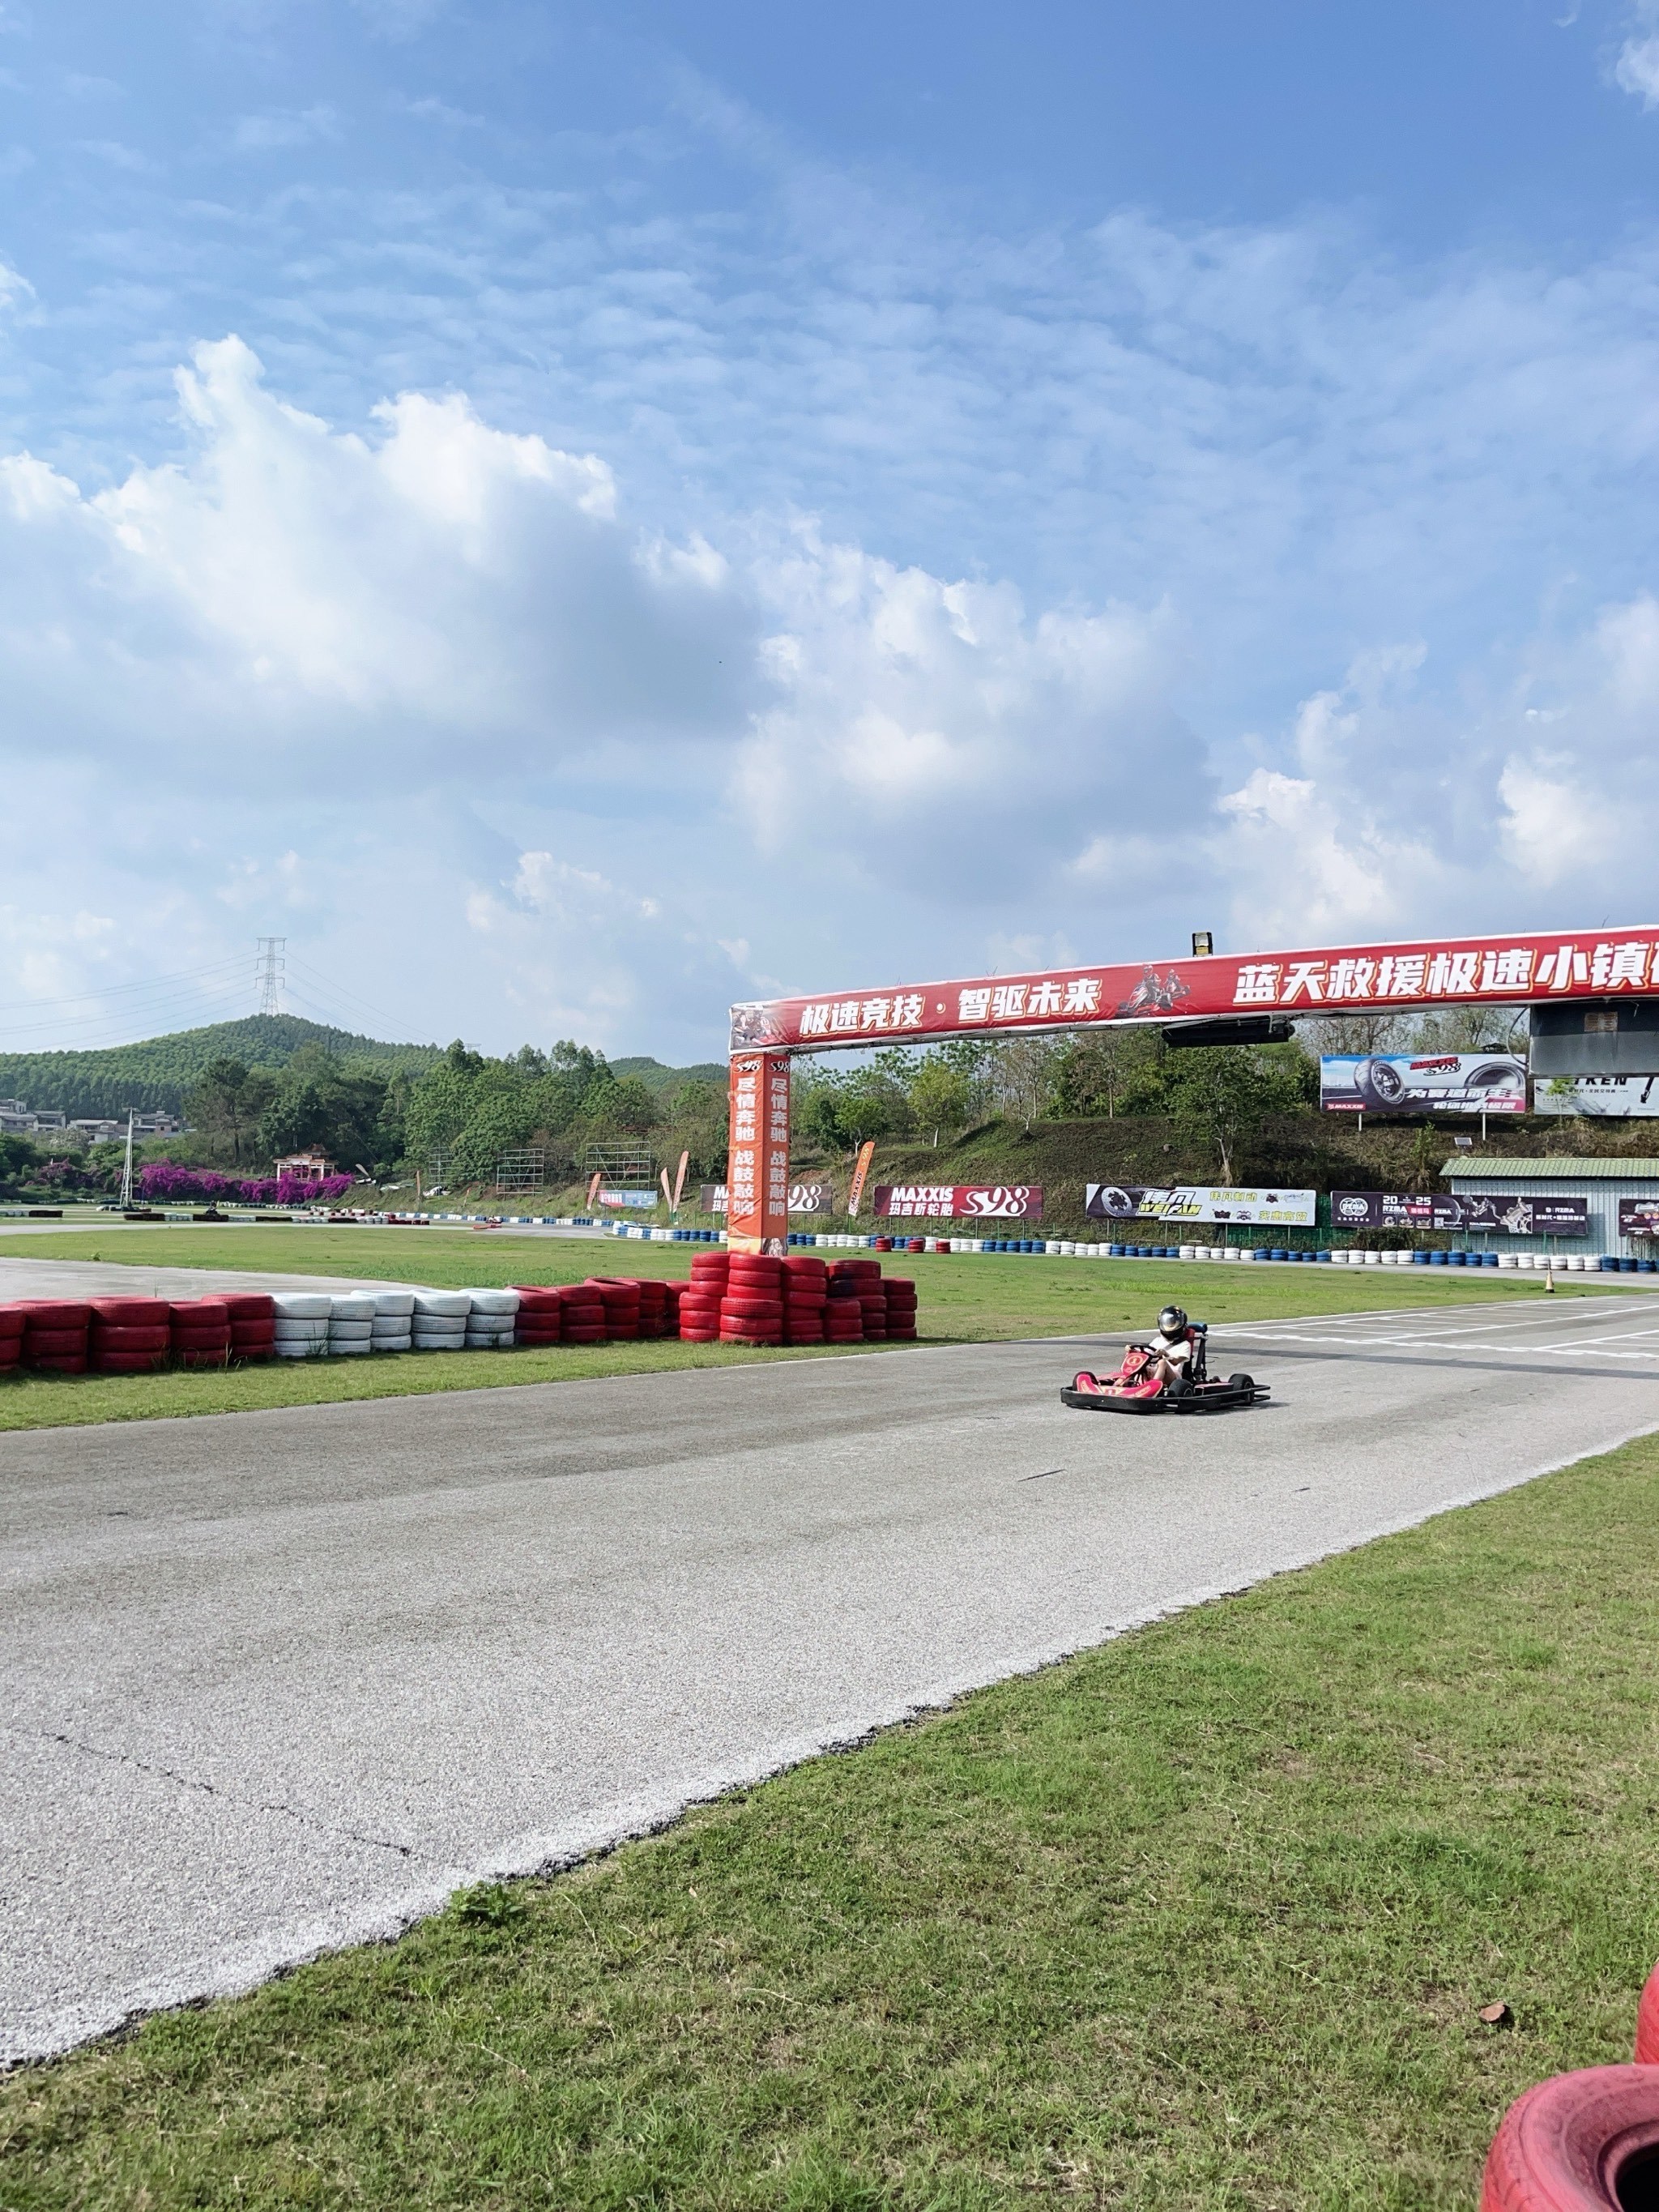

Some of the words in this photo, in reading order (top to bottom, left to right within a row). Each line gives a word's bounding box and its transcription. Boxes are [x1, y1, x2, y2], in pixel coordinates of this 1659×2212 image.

[735, 1077, 756, 1142] 尽情奔驰
[770, 1078, 787, 1142] 尽情奔驰
[733, 1151, 755, 1216] 战鼓敲响
[769, 1151, 787, 1216] 战鼓敲响
[851, 1172, 863, 1205] MAXXIS
[891, 1187, 953, 1202] MAXXIS
[889, 1202, 953, 1216] 玛吉斯轮胎
[960, 1186, 1030, 1216] S98
[1383, 1196, 1397, 1204] 20
[1416, 1197, 1431, 1206] 25
[1383, 1205, 1407, 1213] RZMA
